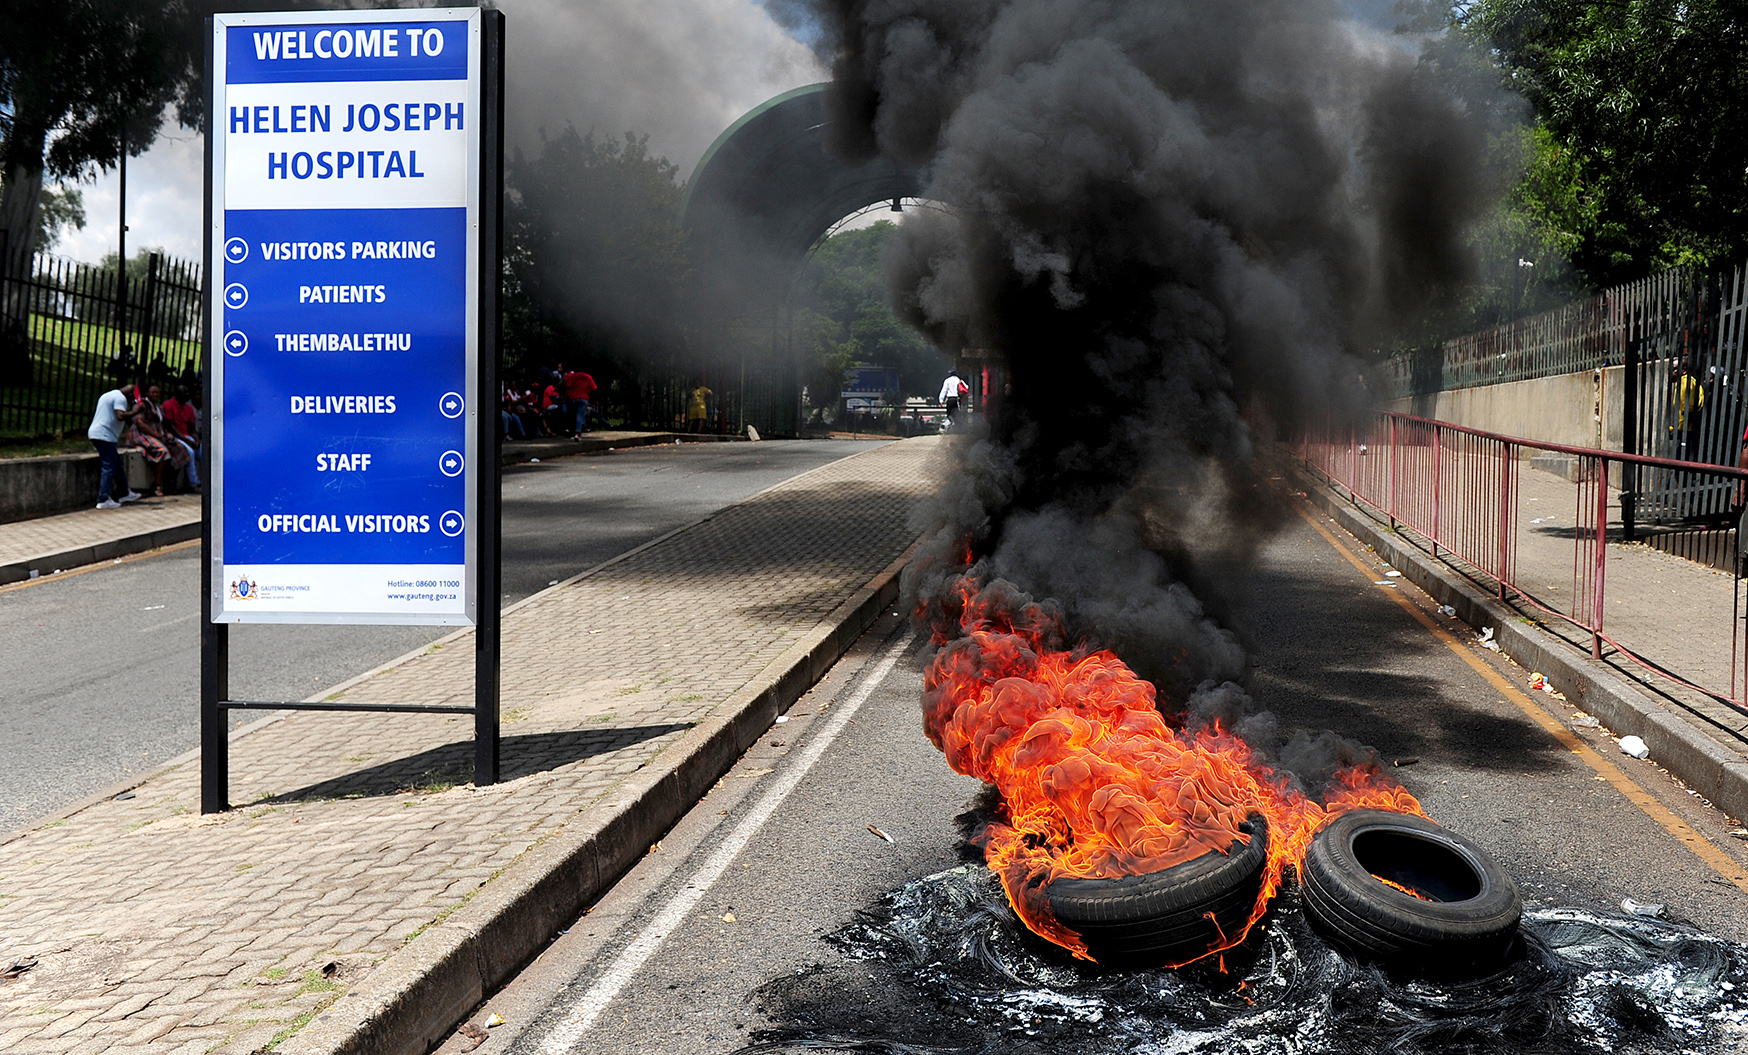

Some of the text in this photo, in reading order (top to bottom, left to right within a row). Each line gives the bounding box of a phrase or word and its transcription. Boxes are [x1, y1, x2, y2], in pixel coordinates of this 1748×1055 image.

[253, 28, 445, 60] WELCOME TO
[230, 102, 464, 134] HELEN JOSEPH
[268, 150, 425, 180] HOSPITAL
[260, 240, 436, 261] VISITORS PARKING
[299, 284, 386, 304] PATIENTS
[274, 333, 412, 352] THEMBALETHU
[290, 395, 397, 414] DELIVERIES
[316, 453, 372, 472] STAFF
[257, 514, 430, 533] OFFICIAL VISITORS
[387, 580, 460, 588] Hotline: 08600 11000
[387, 593, 457, 602] www.gauteng.gov.za
